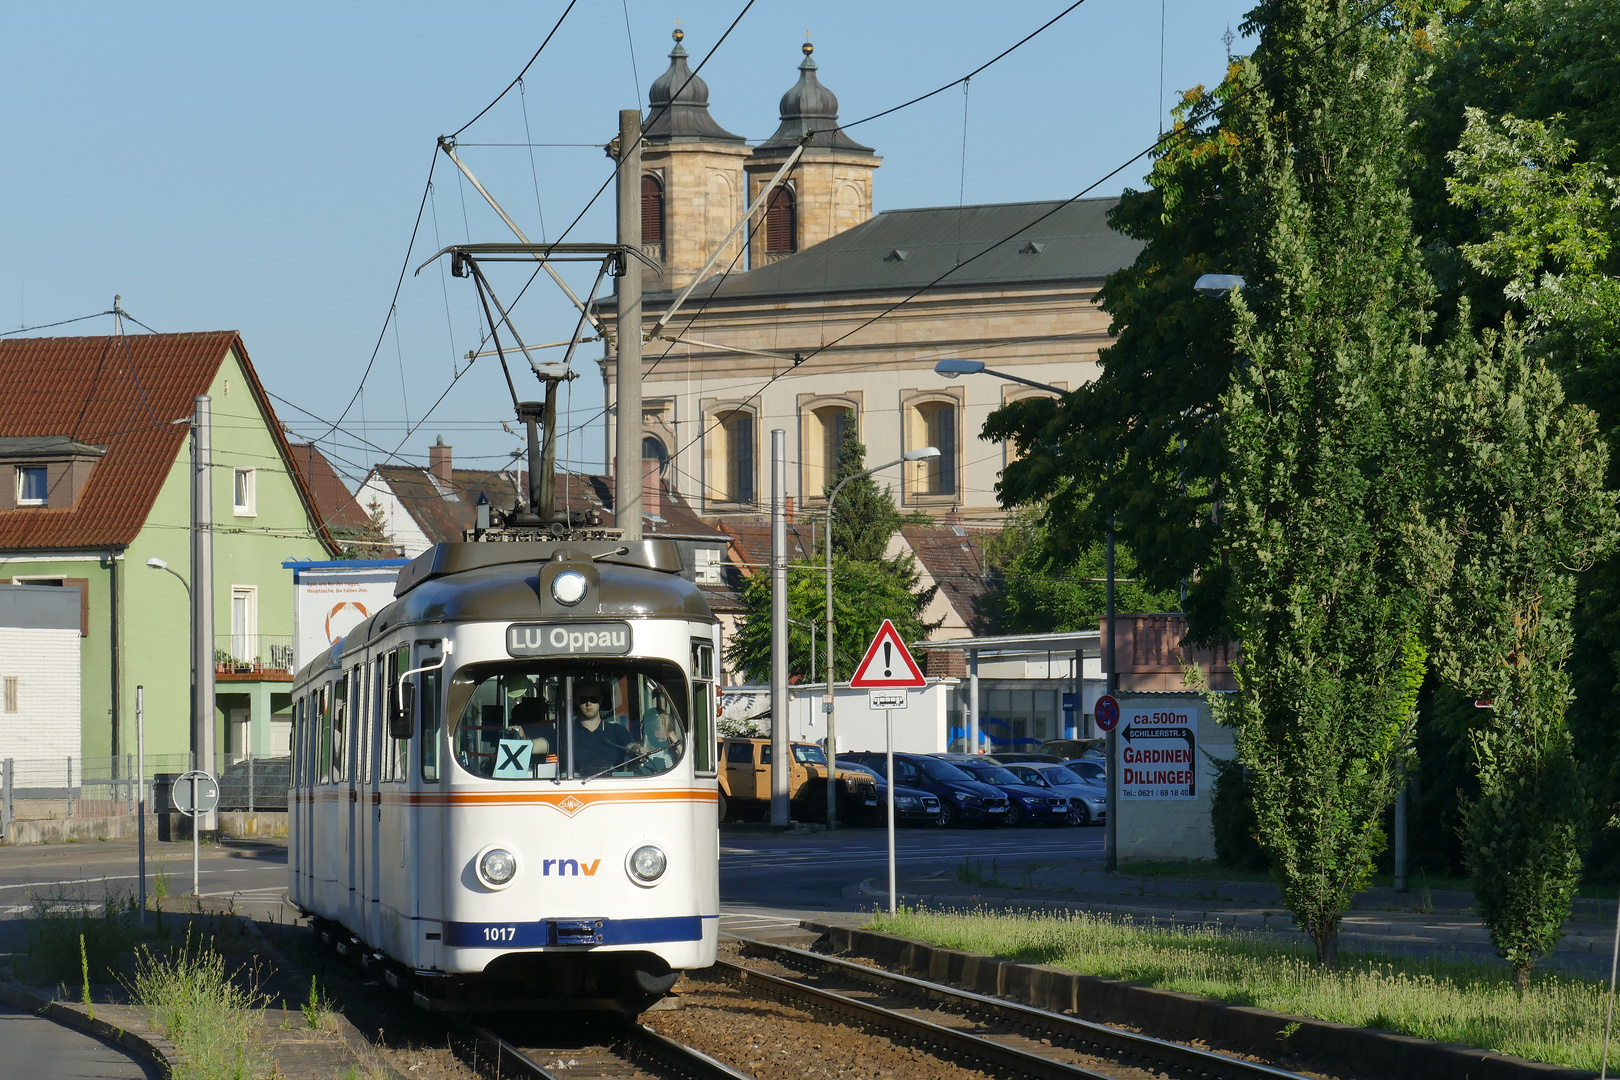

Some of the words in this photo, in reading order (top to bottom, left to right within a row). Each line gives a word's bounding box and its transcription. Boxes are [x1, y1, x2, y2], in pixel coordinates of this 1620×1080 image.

[512, 629, 542, 648] LU
[550, 628, 625, 652] Oppau
[1134, 712, 1188, 724] ca.500m
[497, 744, 528, 771] X
[1123, 747, 1192, 764] GARDINEN
[1124, 768, 1193, 785] DILLINGER
[543, 859, 601, 876] rnv
[484, 928, 515, 940] 1017
